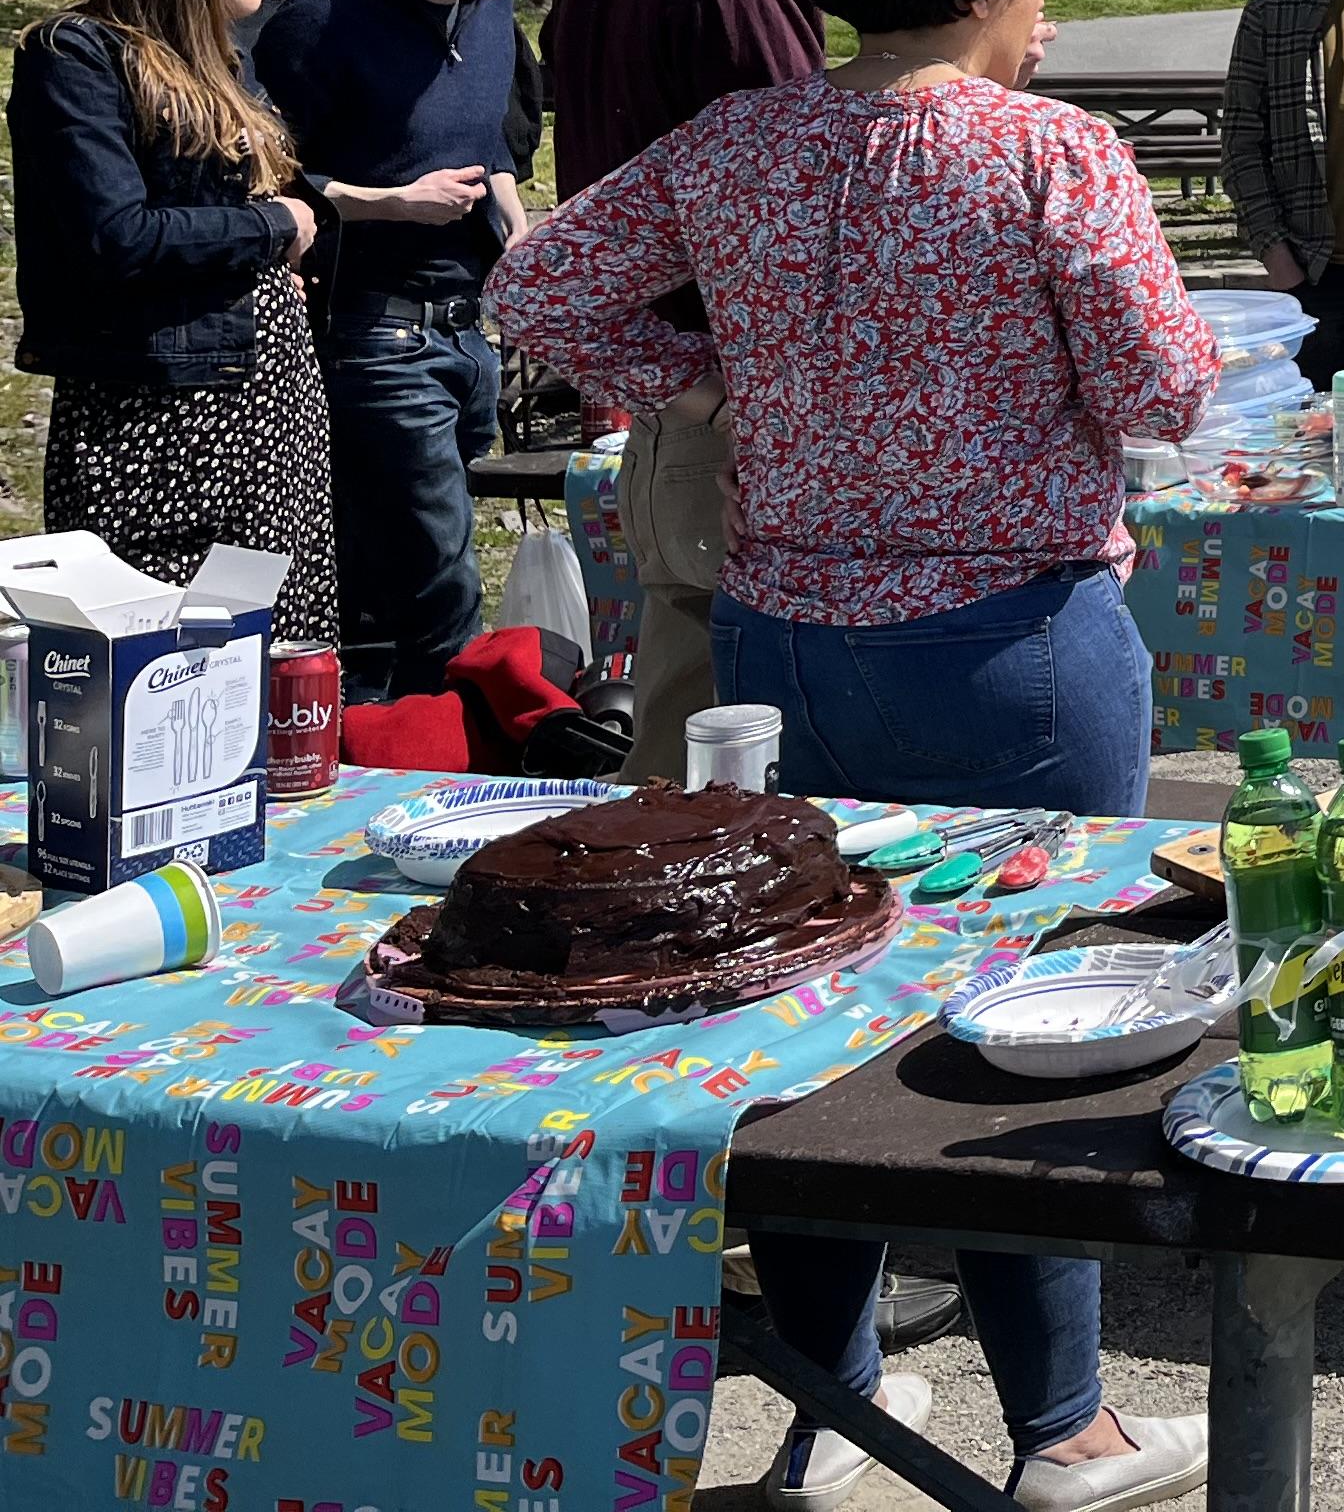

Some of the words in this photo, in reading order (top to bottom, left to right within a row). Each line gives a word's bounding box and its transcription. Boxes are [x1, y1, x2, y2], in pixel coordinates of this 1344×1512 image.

[1176, 539, 1200, 616] VIBES
[1198, 521, 1222, 636] SUMMER
[1243, 545, 1268, 633] VACAY
[1264, 546, 1290, 636] MODE
[1292, 574, 1316, 664] VACAY
[1313, 576, 1338, 667] MODE
[44, 651, 91, 674] Chinet
[148, 657, 206, 690] Chinet
[1155, 651, 1247, 677] UMMER
[1157, 677, 1225, 701] VIBES
[1250, 692, 1333, 720] MODE
[51, 812, 61, 824] 32
[43, 862, 53, 874] 32
[0, 1022, 114, 1051] ODE
[0, 1117, 126, 1175] MOD
[0, 1173, 126, 1224] VACA
[612, 1208, 725, 1256] CAY
[160, 1160, 200, 1321] VIBES
[199, 1122, 243, 1370] SUMMER
[282, 1175, 333, 1369] VACAY
[312, 1179, 380, 1374] MODE
[4, 1260, 62, 1456] MODE
[352, 1240, 428, 1439] VACAY
[396, 1245, 455, 1442] MODE
[86, 1396, 266, 1463] SUMMER
[613, 1305, 670, 1512] VACAY
[661, 1305, 721, 1512] MODE
[114, 1454, 229, 1512] VIBES
